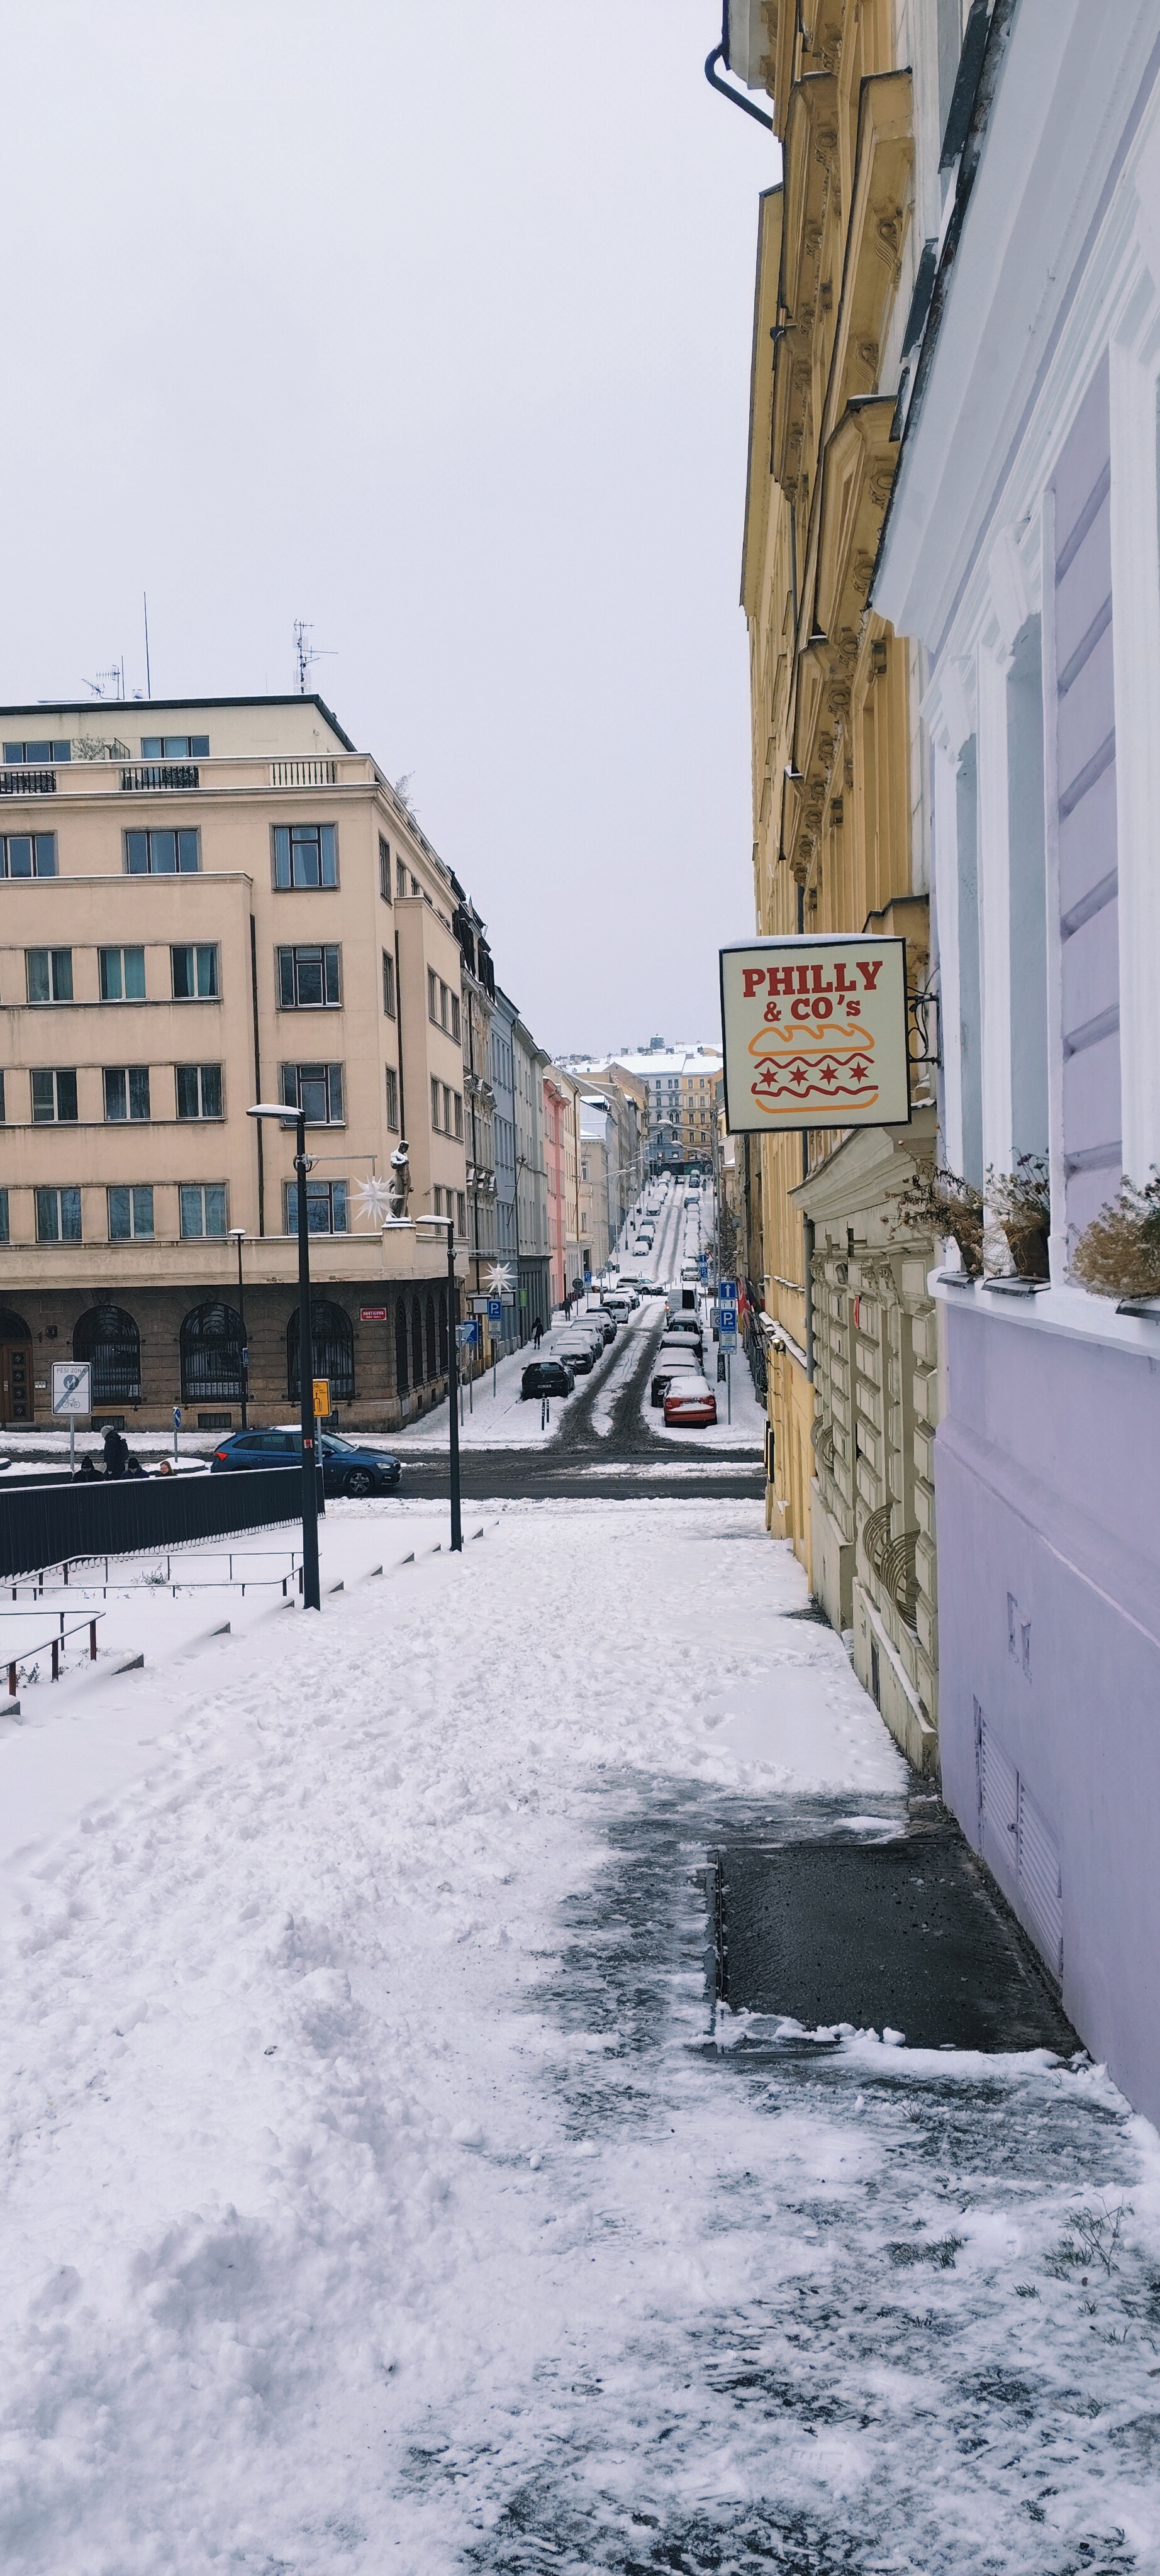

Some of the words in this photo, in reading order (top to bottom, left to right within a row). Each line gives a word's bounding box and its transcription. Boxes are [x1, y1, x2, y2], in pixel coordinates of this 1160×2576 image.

[742, 961, 883, 997] PHILLY
[763, 1001, 782, 1022] &
[491, 1302, 499, 1314] P
[723, 1312, 733, 1325] P
